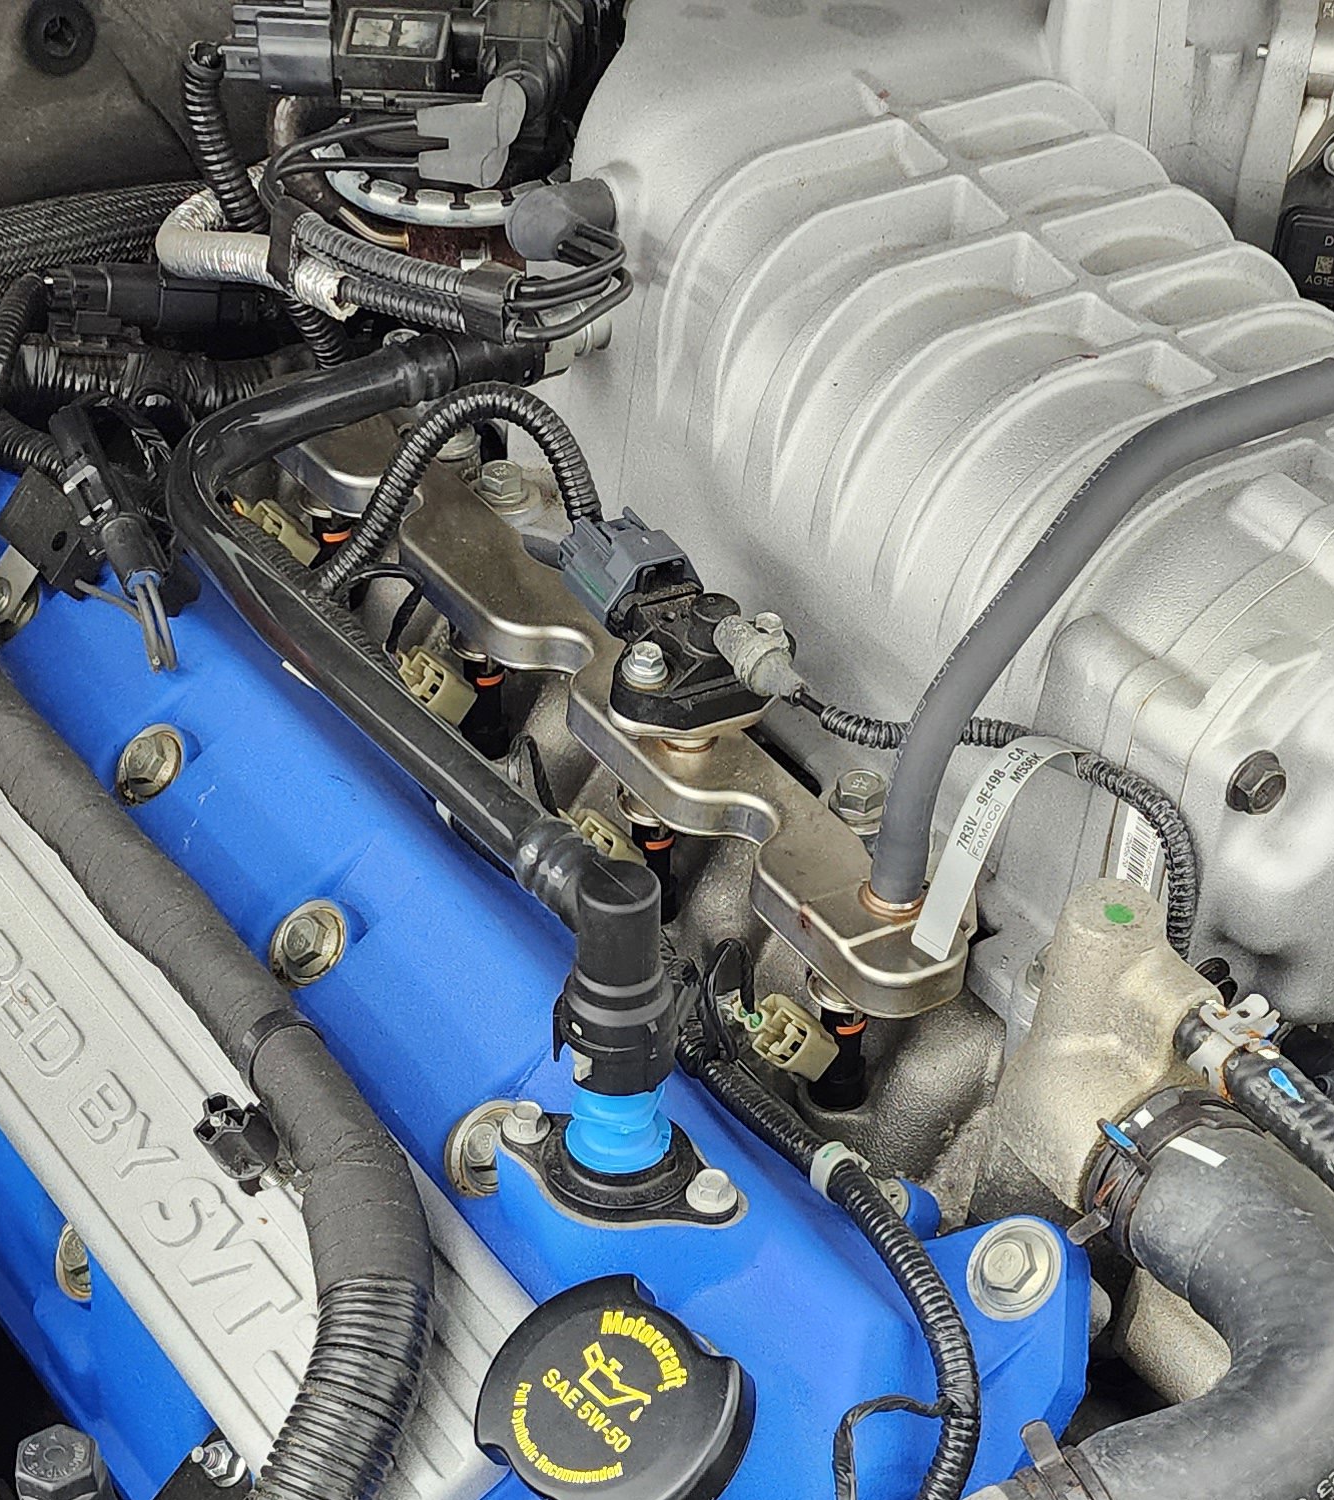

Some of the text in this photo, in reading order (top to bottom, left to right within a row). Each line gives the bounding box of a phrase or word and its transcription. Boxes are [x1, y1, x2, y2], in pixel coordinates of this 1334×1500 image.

[1010, 752, 1044, 784] M536K
[972, 803, 1004, 858] FoMoCo
[69, 1070, 179, 1181] BY
[140, 1175, 304, 1335] SVT
[600, 1311, 687, 1391] Motorcraft
[512, 1381, 624, 1485] Full Synthetic Recommended
[542, 1368, 632, 1453] SAE 5W-50
